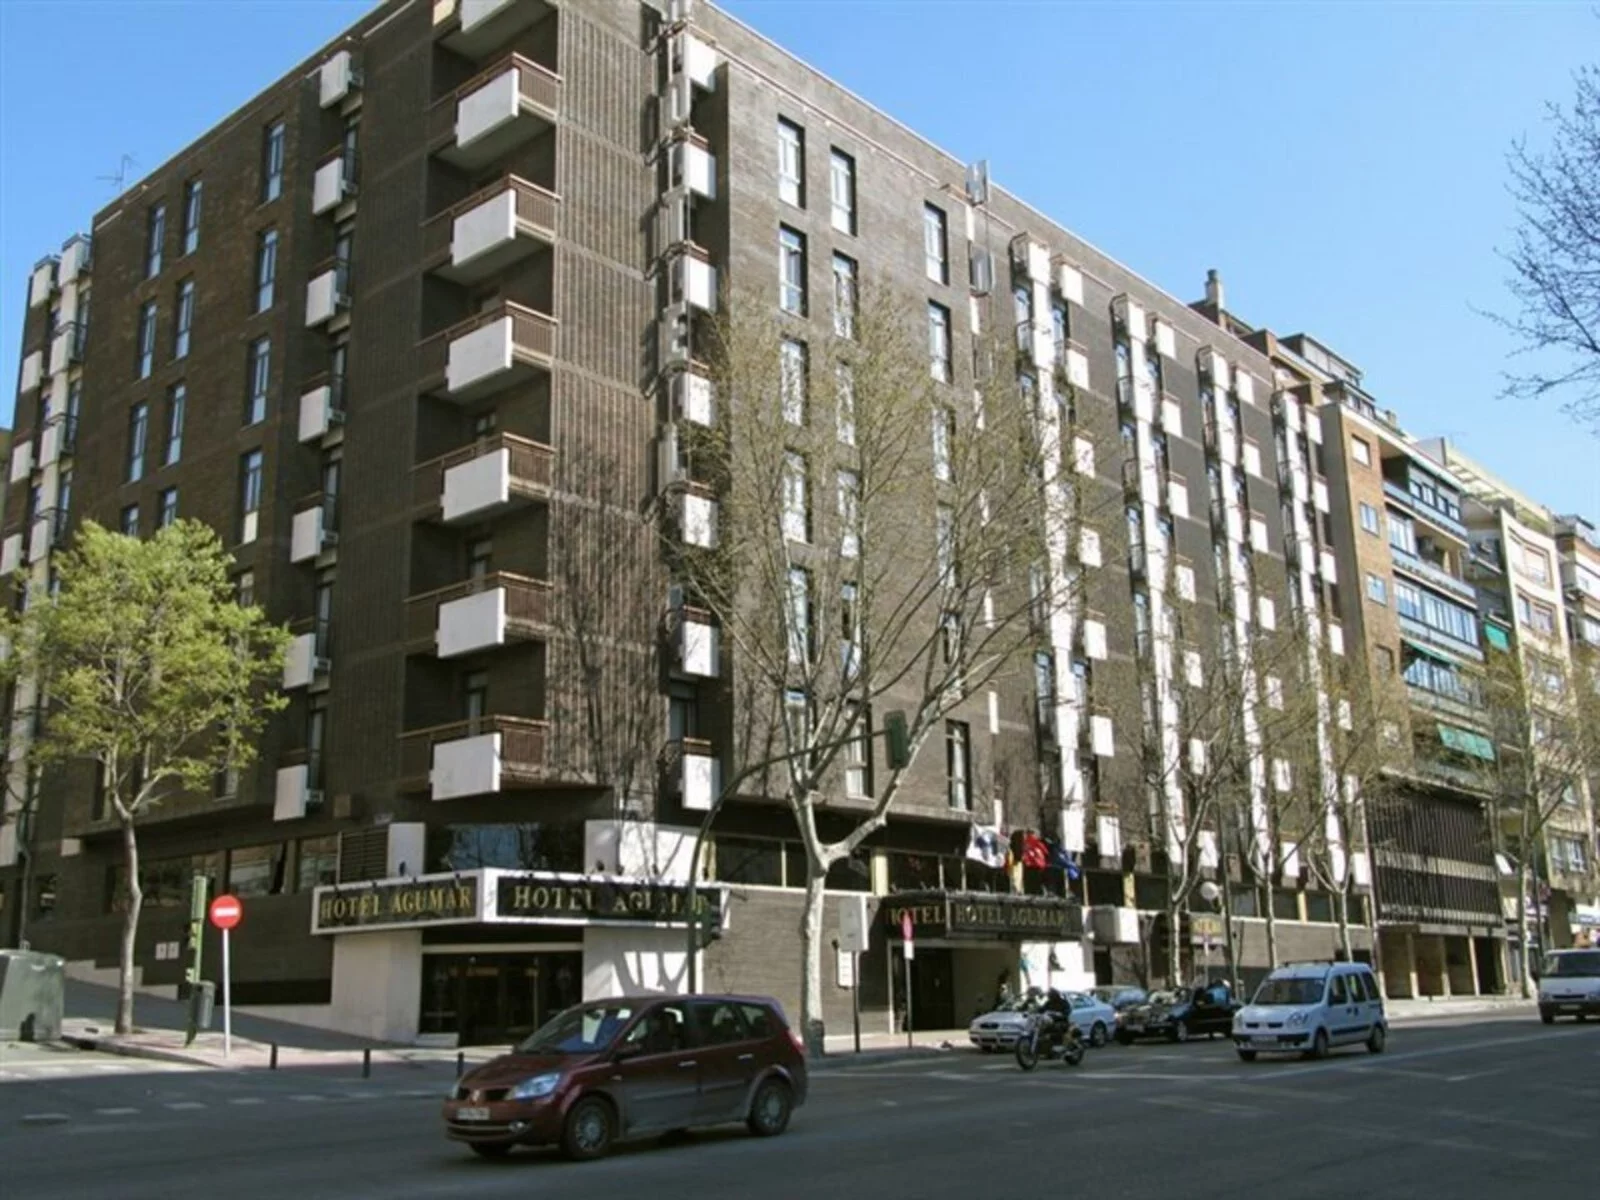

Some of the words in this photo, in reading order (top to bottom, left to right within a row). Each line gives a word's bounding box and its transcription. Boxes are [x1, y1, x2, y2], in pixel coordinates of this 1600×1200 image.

[320, 894, 380, 919] HOTEL
[391, 885, 472, 914] AGUMAR
[513, 885, 595, 911] HOTEL
[955, 903, 1005, 925] HOTEL
